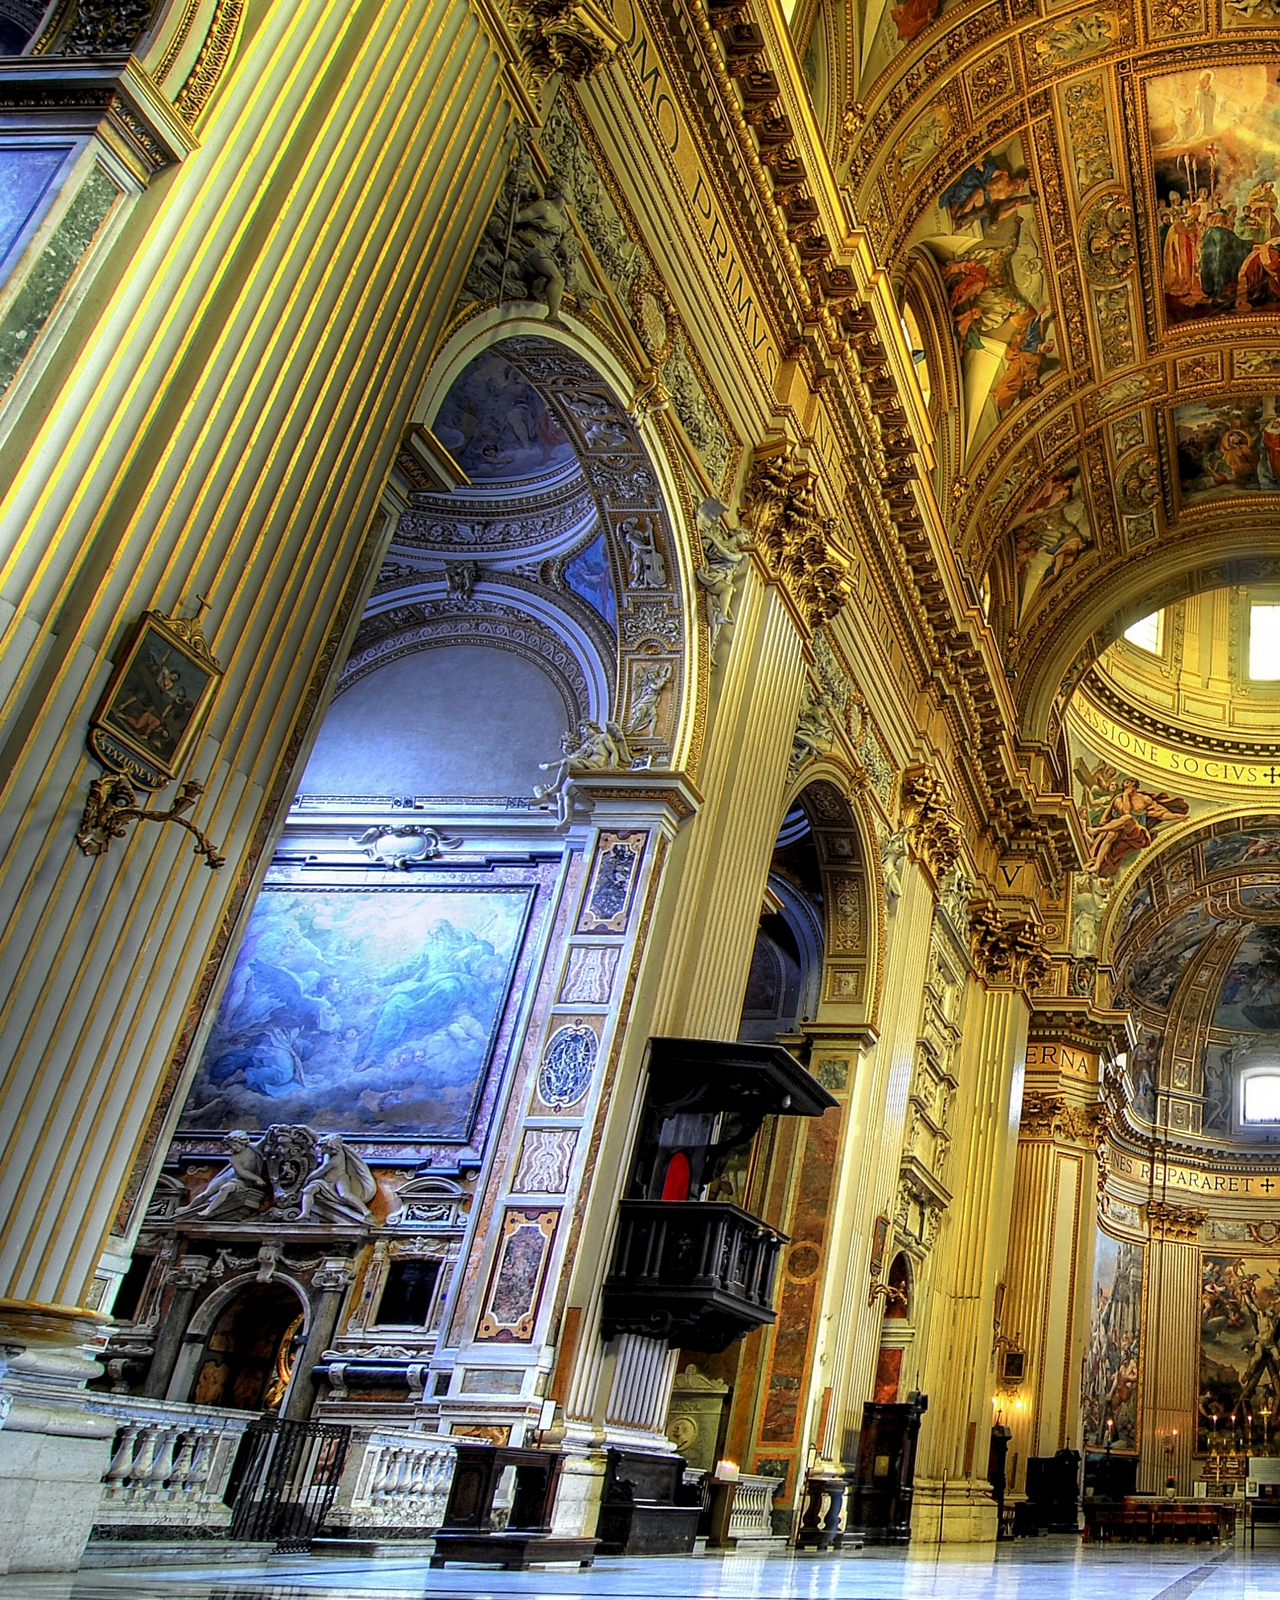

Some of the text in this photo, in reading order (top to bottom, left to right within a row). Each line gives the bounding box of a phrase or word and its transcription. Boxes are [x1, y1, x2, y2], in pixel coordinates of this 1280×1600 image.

[691, 168, 777, 386] PRIMVS
[1077, 696, 1159, 762] PASSIONE
[1169, 753, 1258, 783] SOCIVS
[98, 742, 147, 779] STAZIONE
[999, 865, 1024, 888] V
[1025, 1045, 1089, 1075] ERNA
[1140, 1163, 1254, 1192] REPARARET
